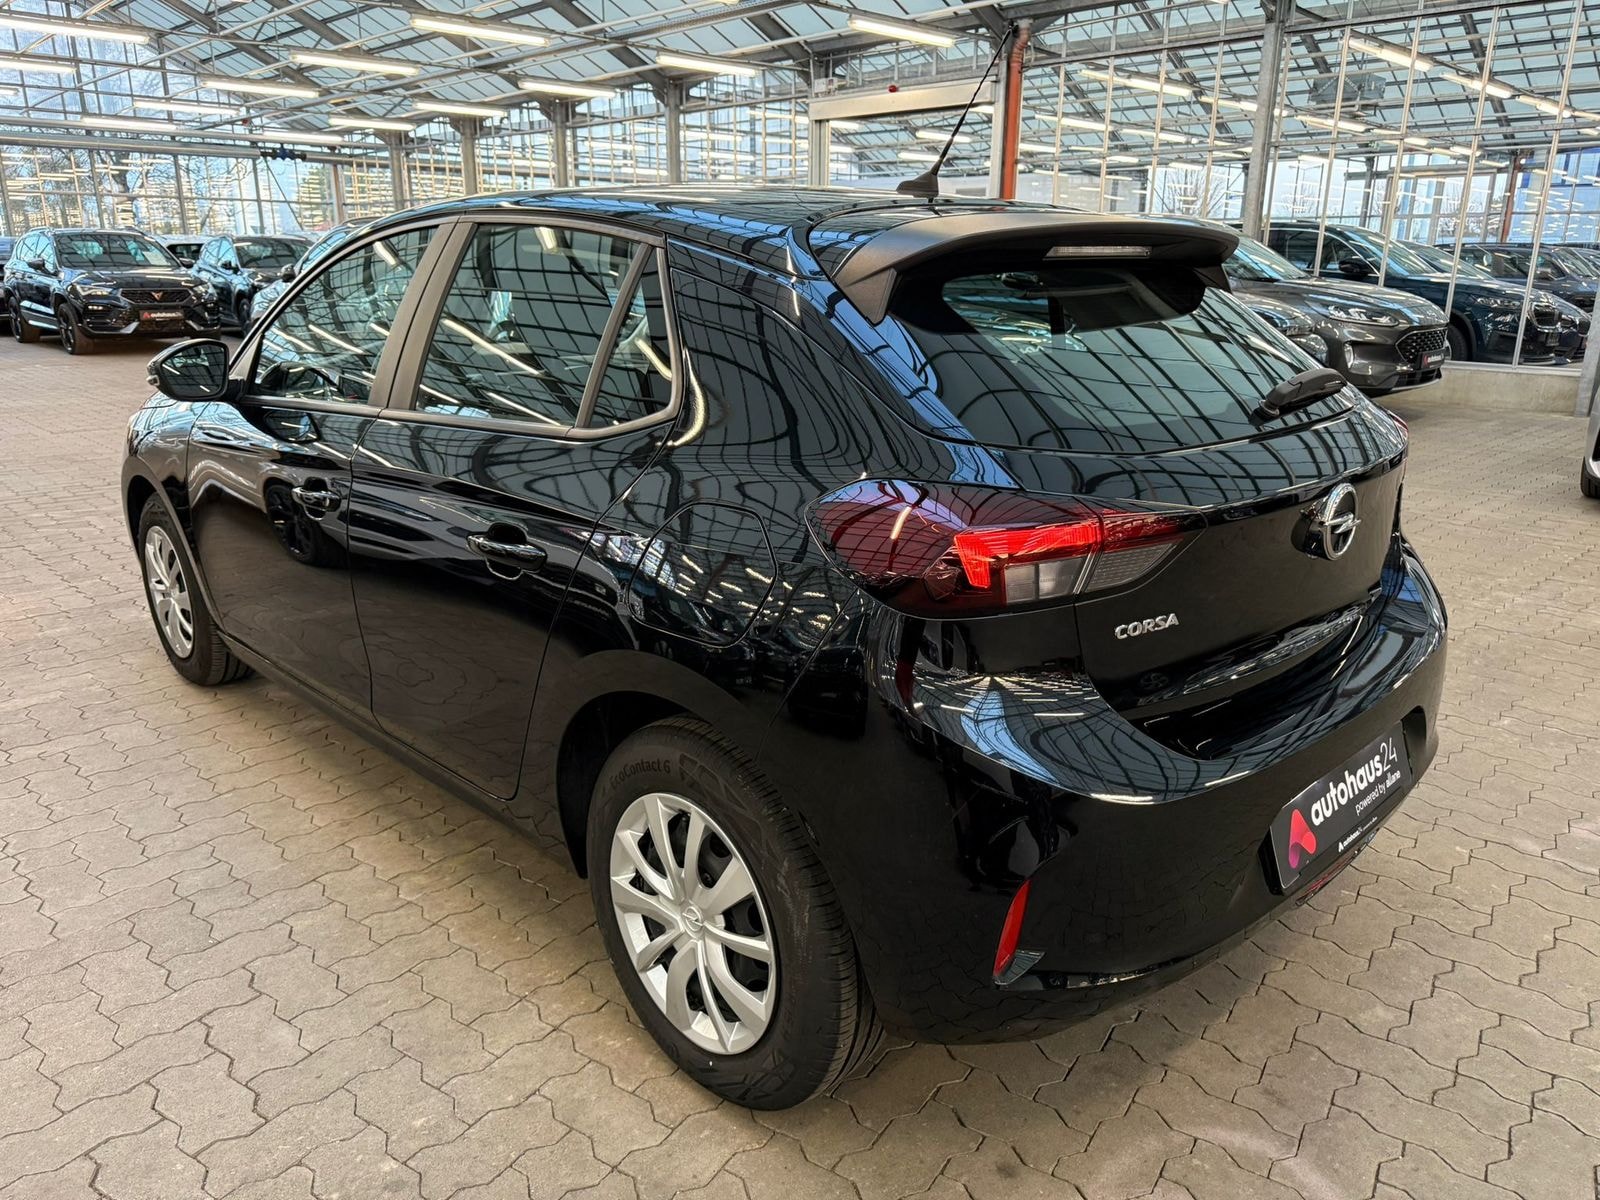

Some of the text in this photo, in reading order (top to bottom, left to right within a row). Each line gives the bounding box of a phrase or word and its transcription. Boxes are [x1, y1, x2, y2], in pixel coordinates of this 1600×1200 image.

[1114, 613, 1180, 640] CORSA
[609, 757, 671, 790] EcoContact 6
[1311, 737, 1398, 826] autohaus24
[1355, 785, 1379, 816] powered
[1378, 782, 1386, 794] by
